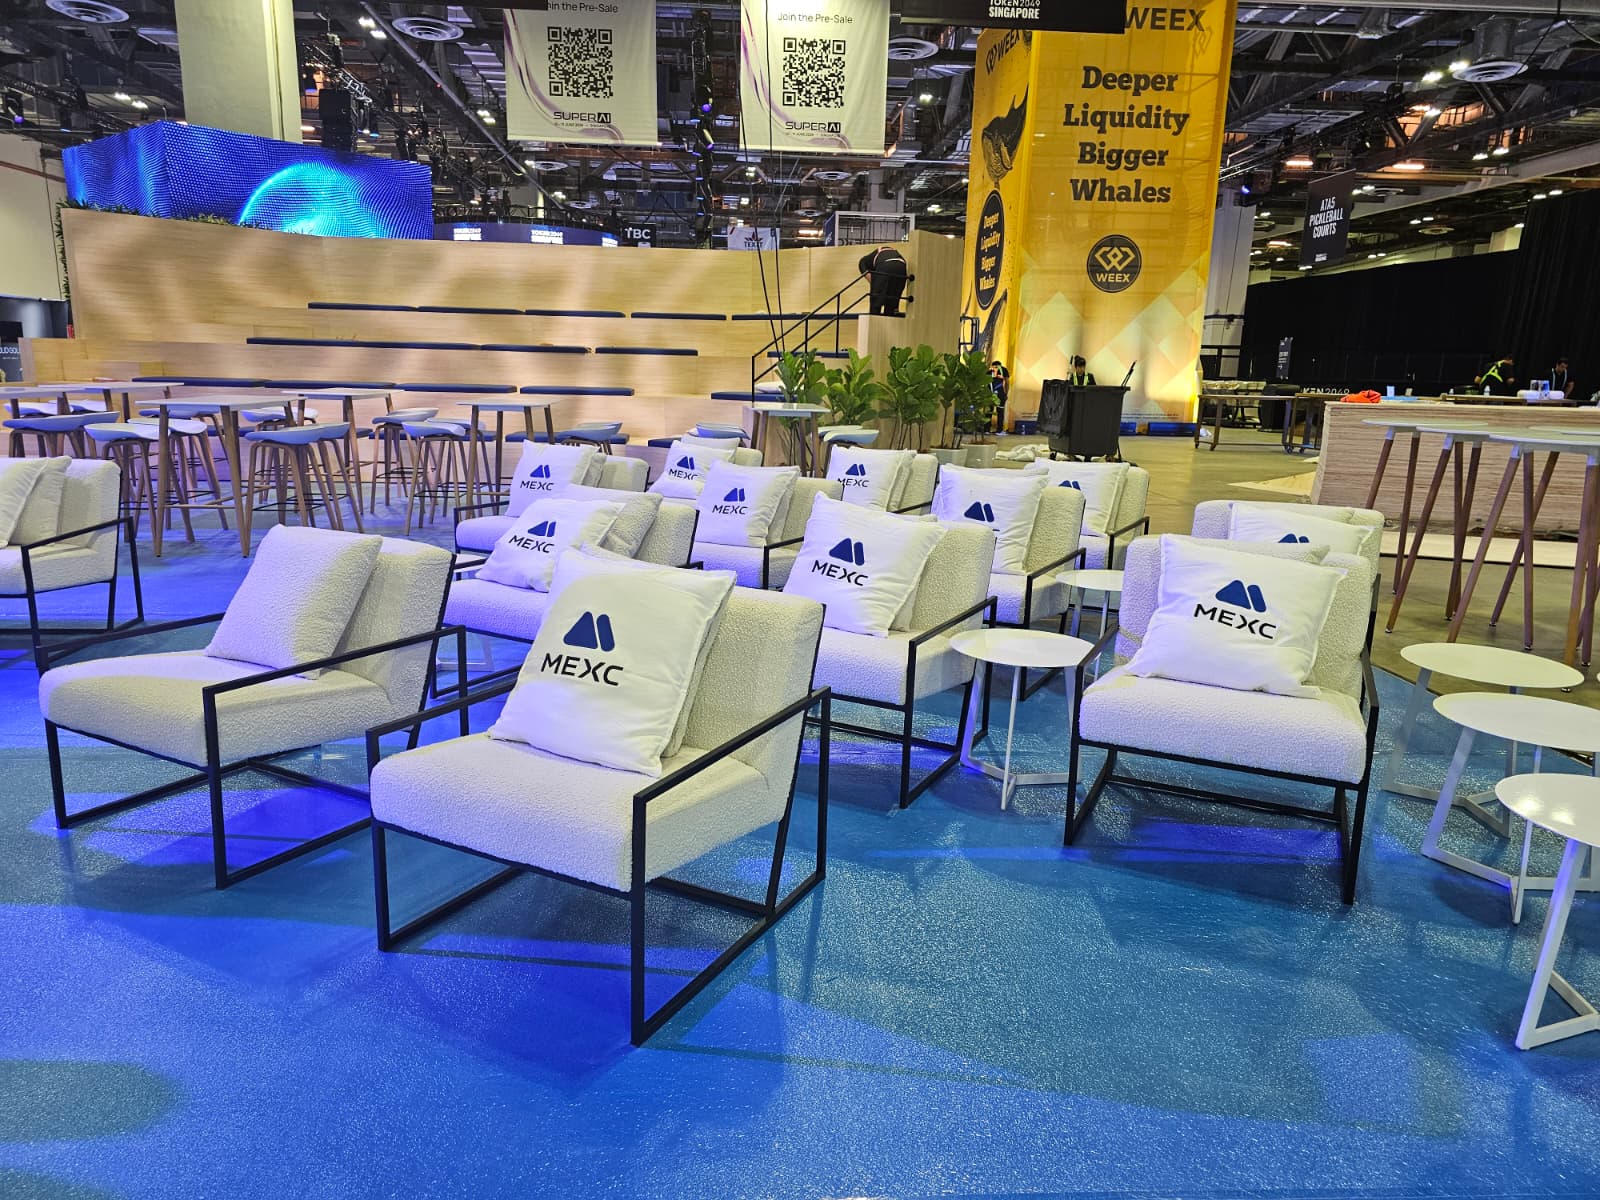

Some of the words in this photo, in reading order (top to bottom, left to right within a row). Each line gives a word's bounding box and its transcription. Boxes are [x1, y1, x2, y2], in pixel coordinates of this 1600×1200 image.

[562, 2, 578, 11] the
[579, 3, 618, 13] Pre-Sale
[989, 6, 1040, 19] SINGAPORE
[778, 12, 797, 21] Join
[798, 13, 814, 22] the
[815, 13, 853, 24] Pre-Sale
[1124, 7, 1206, 32] WEEX
[1081, 65, 1178, 96] Deeper
[1063, 103, 1190, 136] Liquidity
[1077, 142, 1169, 171] Bigger
[1070, 178, 1172, 203] Whales
[1320, 197, 1336, 211] ATAS
[984, 212, 999, 229] Deeper
[1309, 208, 1343, 227] PICKLEBALL
[625, 228, 651, 239] TBC
[1313, 222, 1336, 238] COURTS
[981, 231, 1001, 252] Liquidity
[981, 255, 996, 272] Bigger
[979, 274, 995, 290] Whales
[1096, 273, 1130, 283] WEEX
[520, 480, 554, 491] MEXC
[838, 478, 870, 487] MEXC
[712, 504, 748, 515] MEXC
[508, 534, 555, 553] MEXC
[812, 560, 869, 586] MEXC
[1193, 603, 1277, 640] MEXC
[540, 653, 624, 686] MEXC
